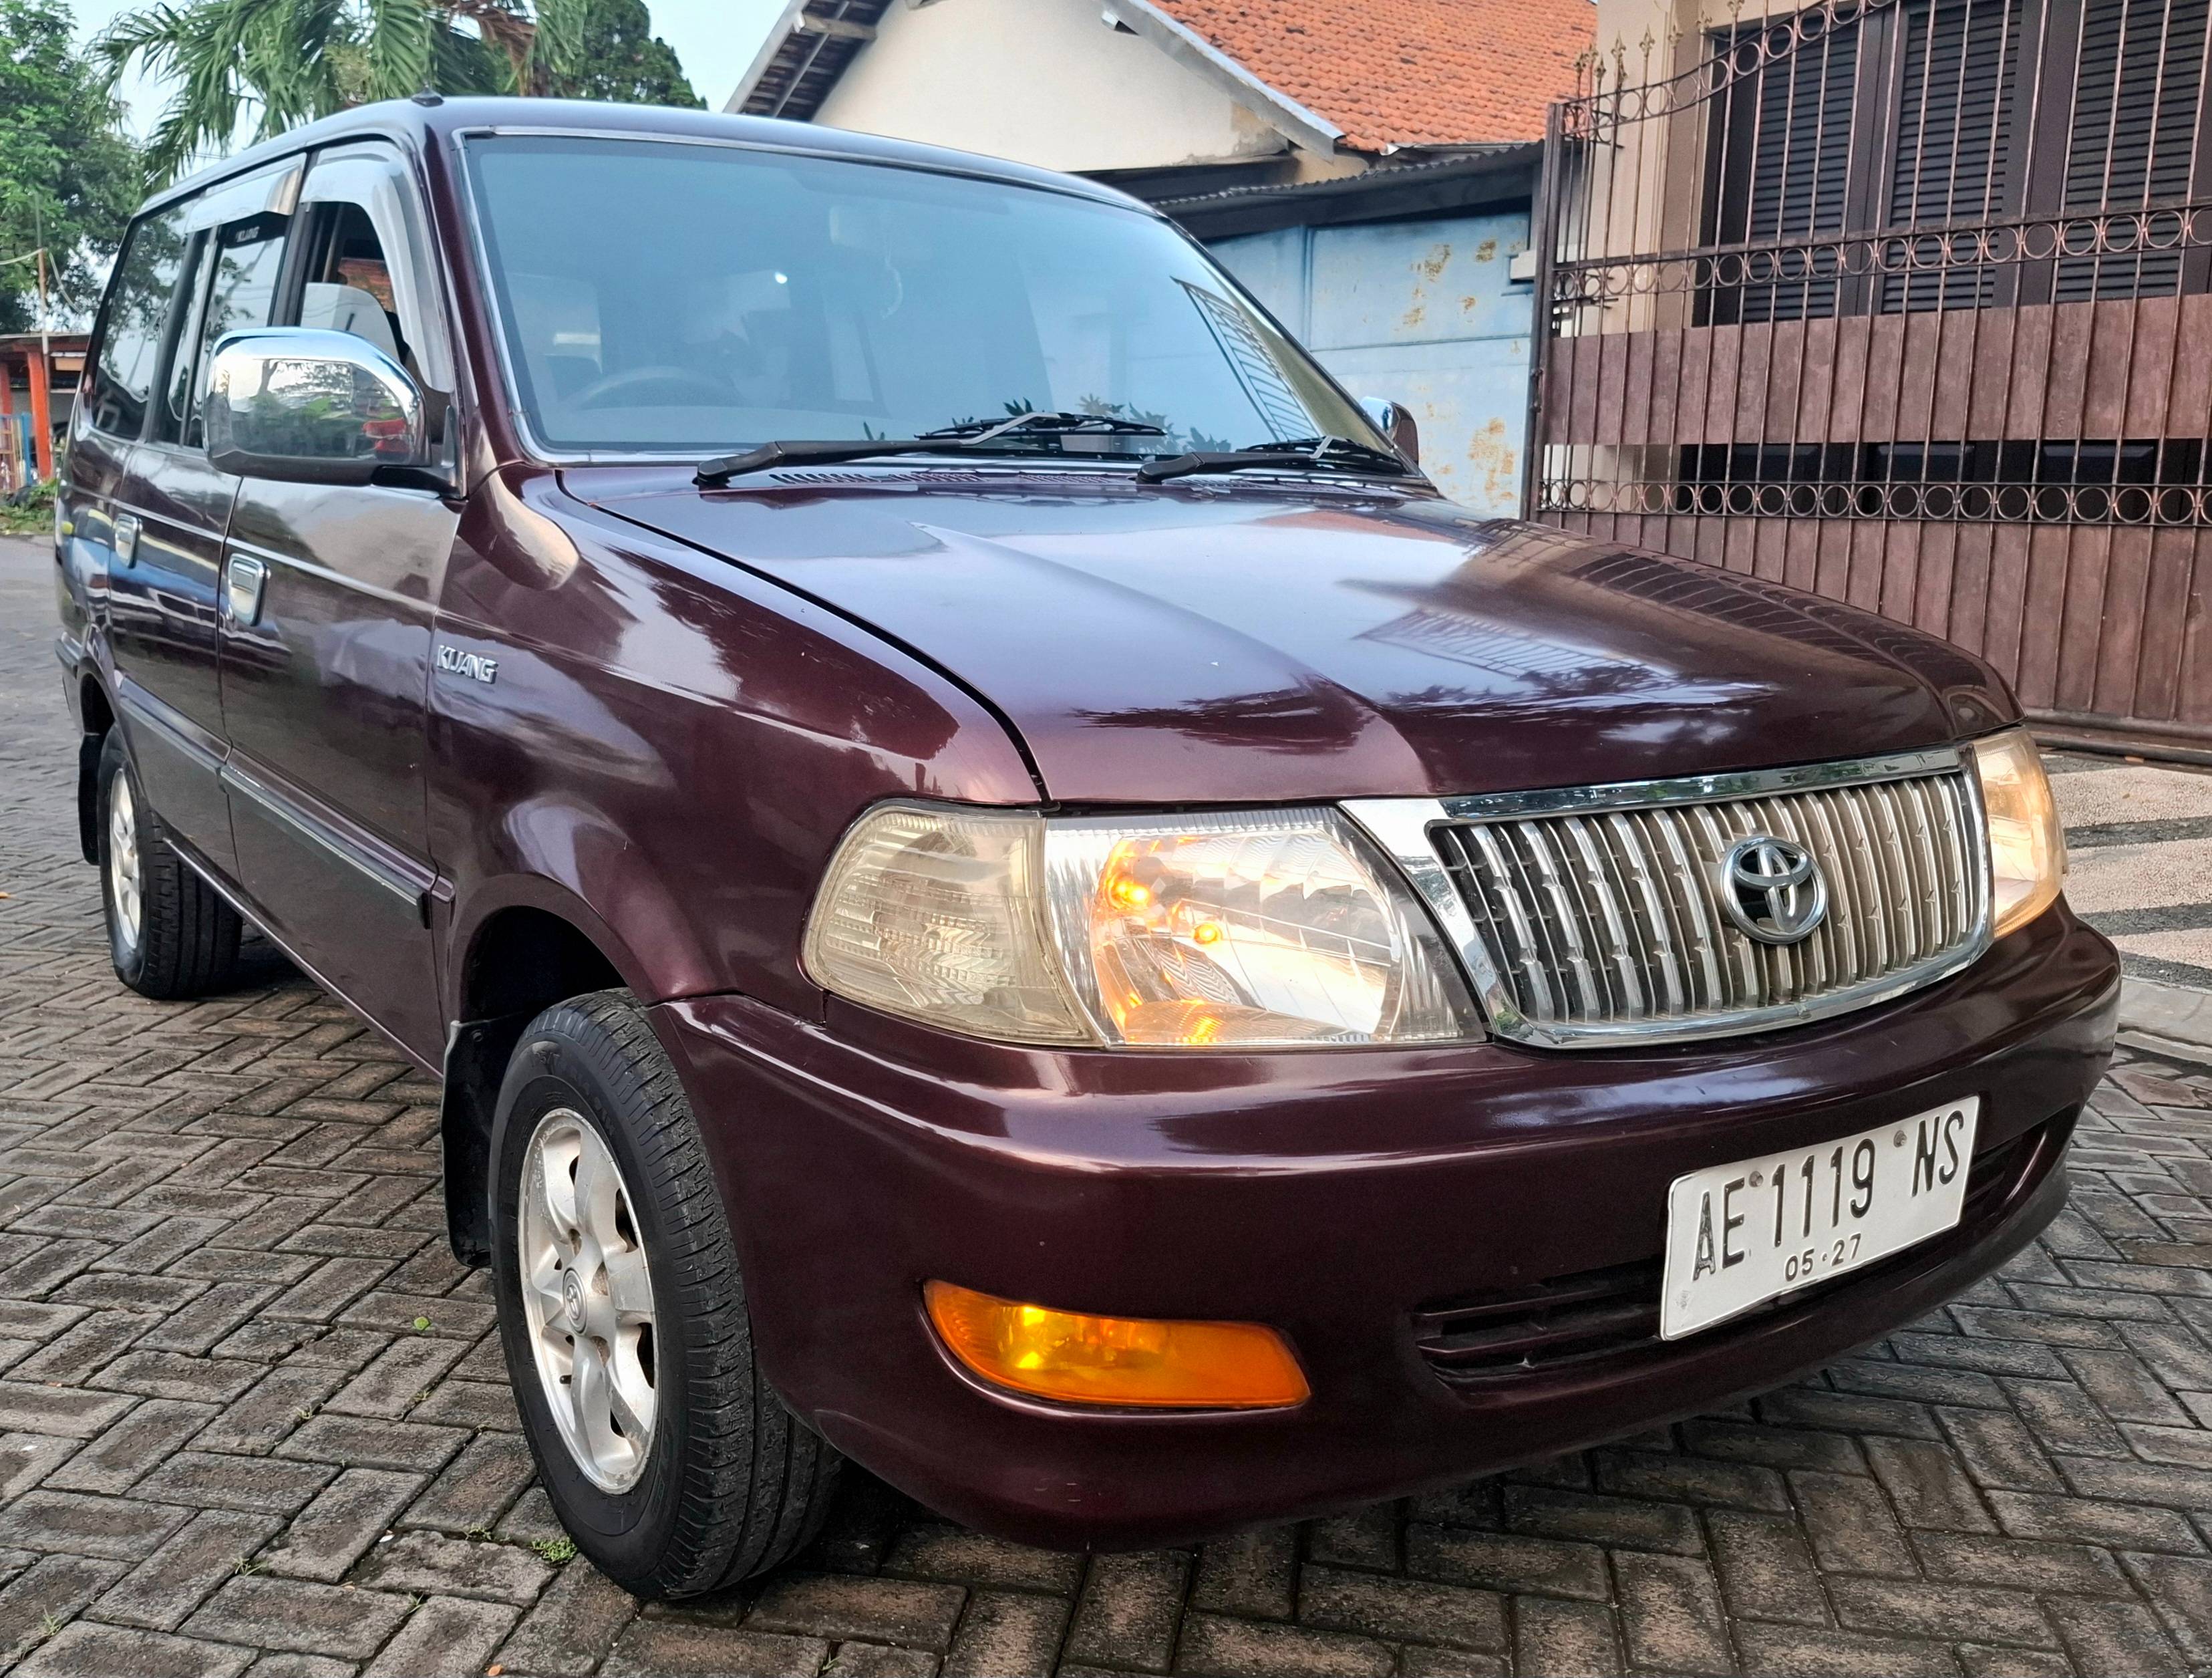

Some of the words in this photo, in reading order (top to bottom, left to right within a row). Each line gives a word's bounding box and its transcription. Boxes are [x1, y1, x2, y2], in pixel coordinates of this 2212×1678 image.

[437, 644, 499, 684] KIJANG
[1692, 1176, 1746, 1282] AE
[1772, 1138, 1876, 1248] 1119
[1911, 1110, 1965, 1198] NS
